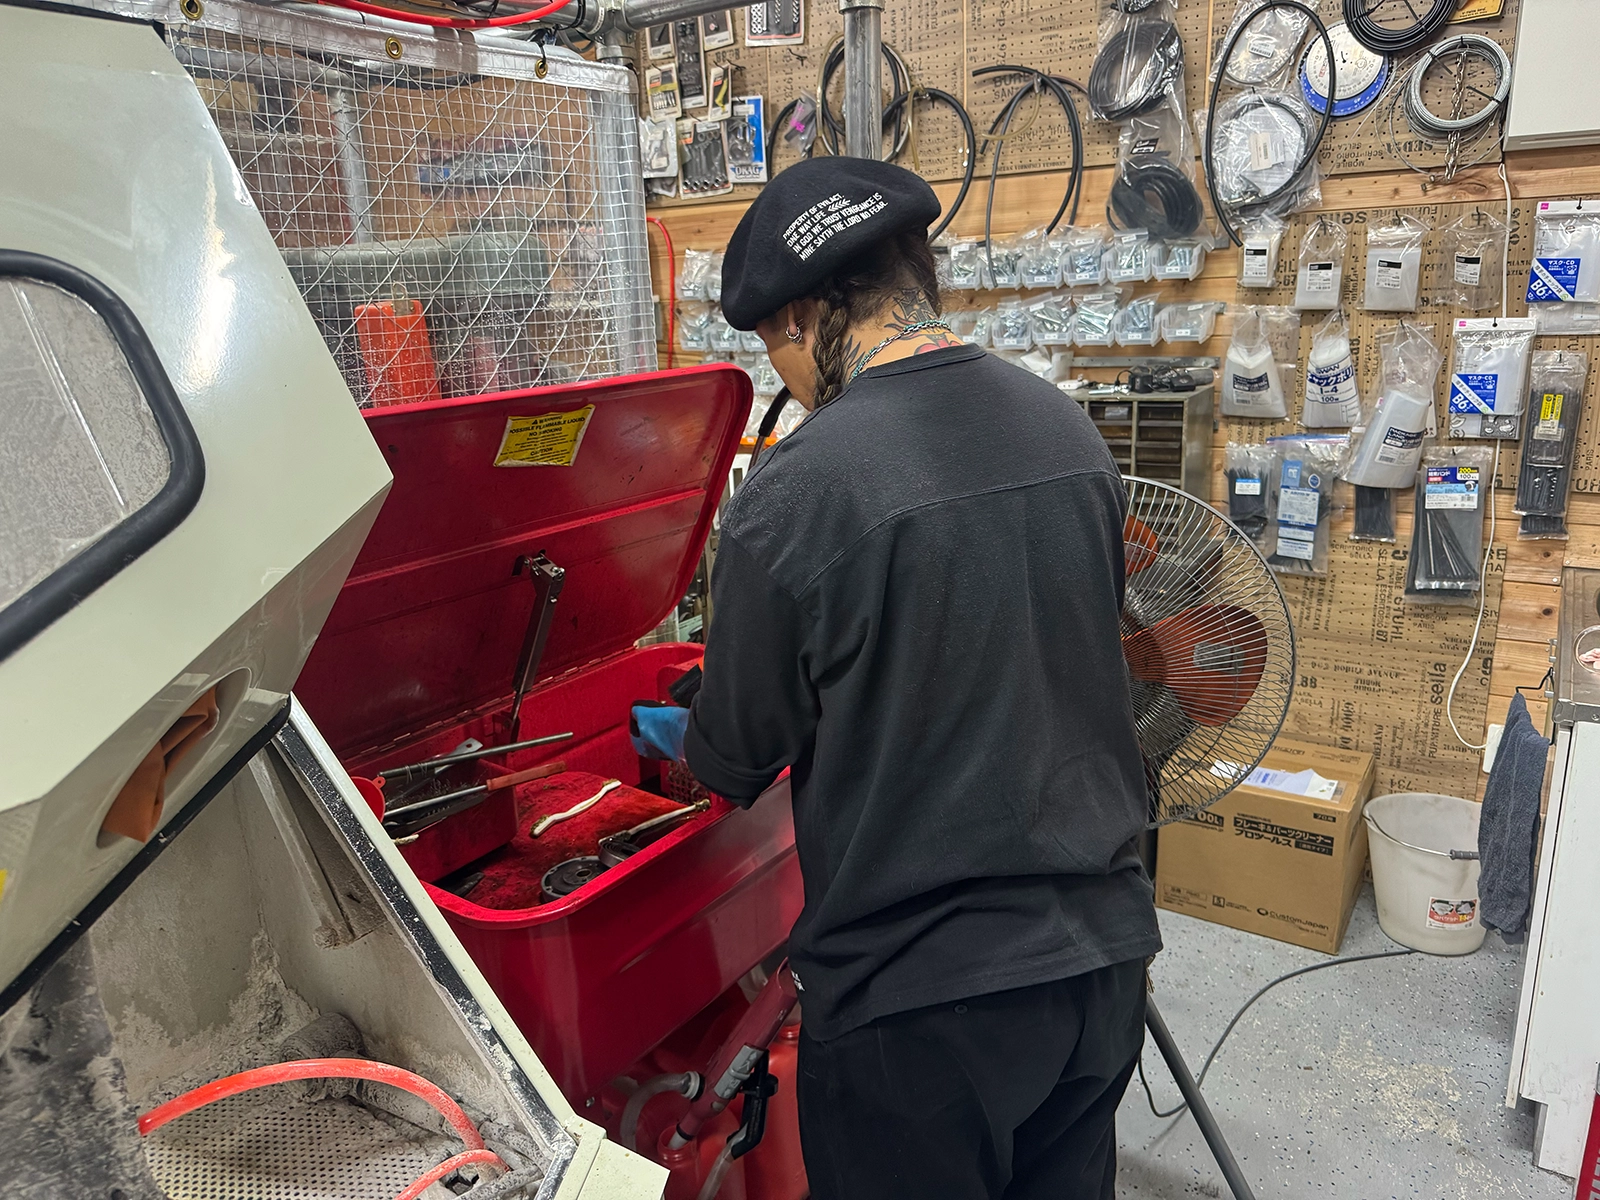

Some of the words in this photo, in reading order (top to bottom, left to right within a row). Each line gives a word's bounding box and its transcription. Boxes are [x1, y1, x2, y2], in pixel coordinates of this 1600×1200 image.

[783, 211, 810, 240] PROPERTY
[809, 206, 818, 215] OF
[787, 232, 800, 247] ONE
[798, 219, 812, 234] WAY
[811, 211, 827, 223] LIFE
[792, 243, 802, 253] IN
[800, 232, 814, 246] GOD
[811, 223, 823, 235] WE
[820, 212, 842, 227] TRUST
[840, 197, 876, 217] VENGEANCE
[873, 192, 882, 201] IS
[799, 244, 817, 261] MINE
[813, 228, 834, 247] SAYTH
[831, 221, 847, 232] THE
[843, 214, 862, 227] LORD
[860, 211, 872, 220] NO
[869, 201, 888, 214] FEAR.
[1530, 279, 1549, 297] B6
[1452, 393, 1470, 409] B6
